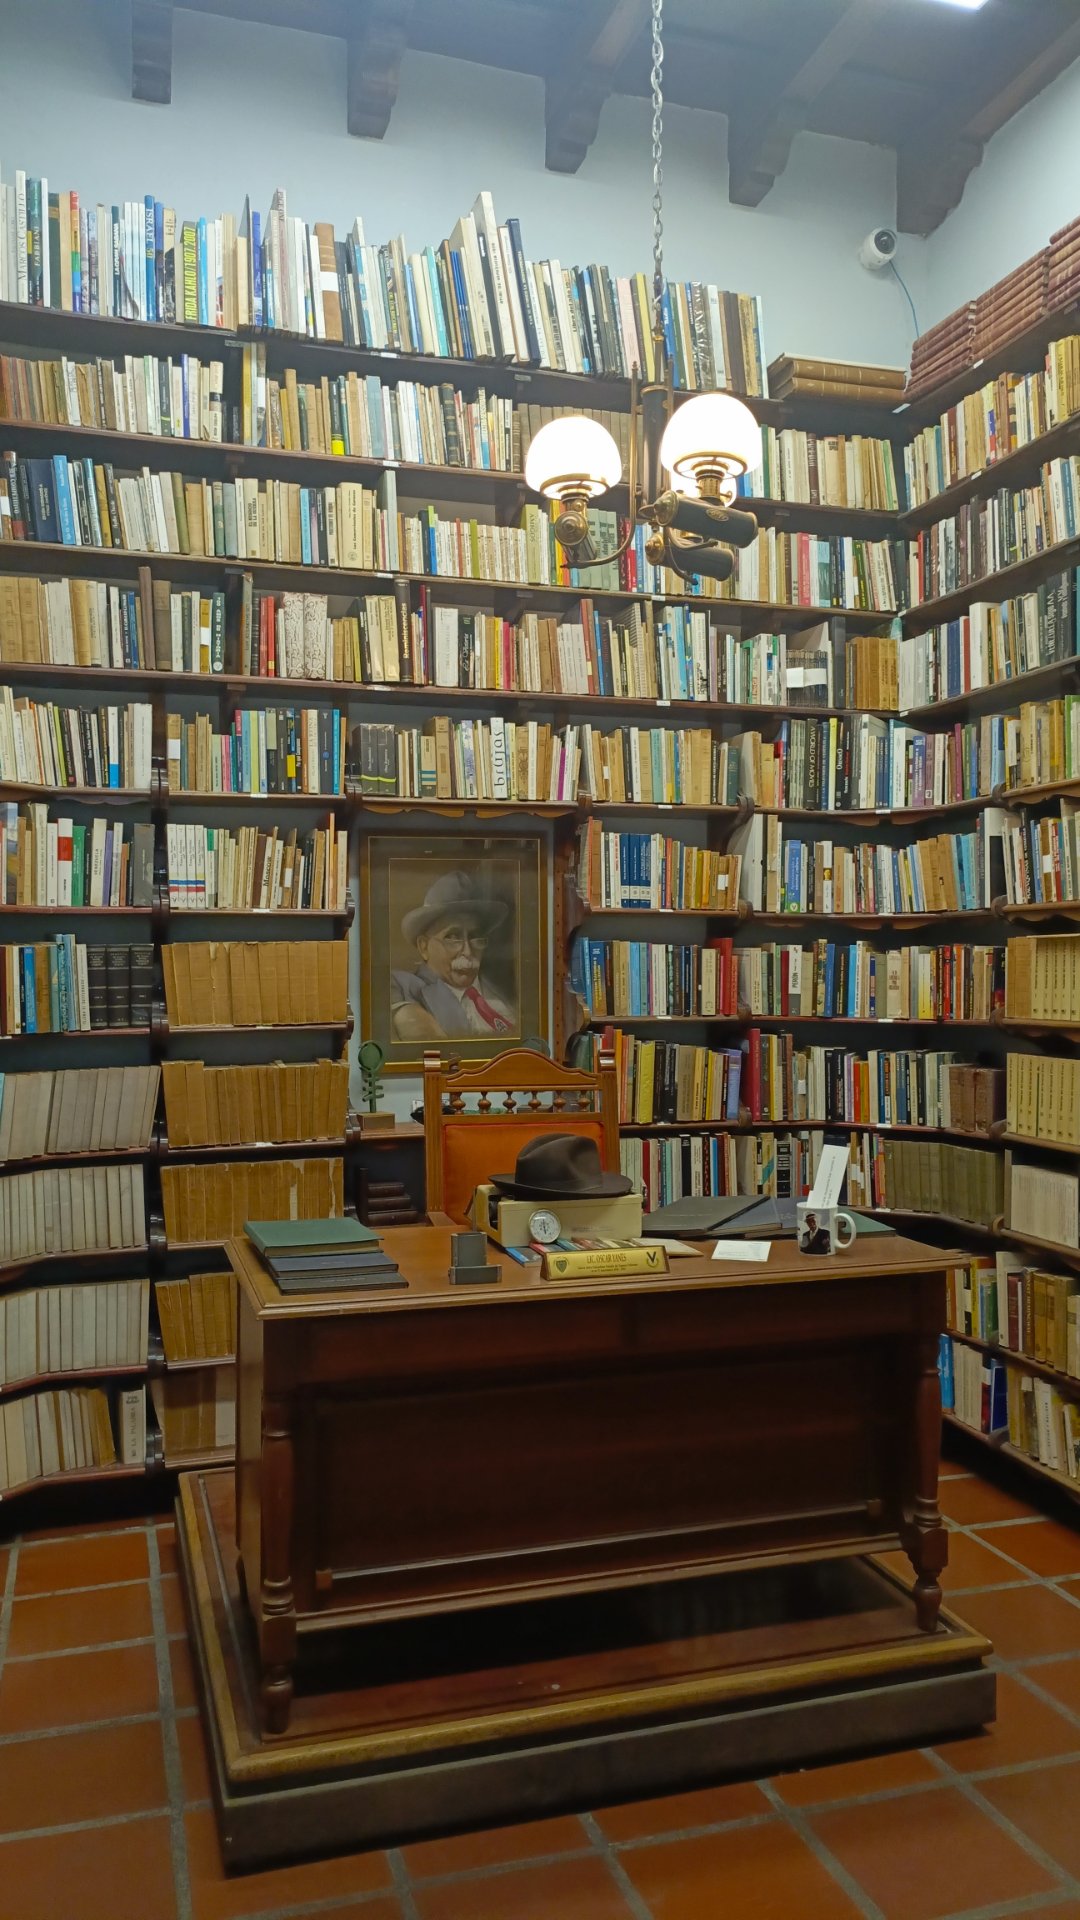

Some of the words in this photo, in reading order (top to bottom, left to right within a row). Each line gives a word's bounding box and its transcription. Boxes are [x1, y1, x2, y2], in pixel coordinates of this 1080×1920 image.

[17, 193, 26, 239] CASTILLO
[17, 241, 26, 281] MARCOS
[146, 249, 153, 259] 50
[185, 297, 196, 320] FRIDA
[494, 731, 506, 787] brujas
[808, 755, 815, 764] OF
[596, 1254, 611, 1263] OSCAR
